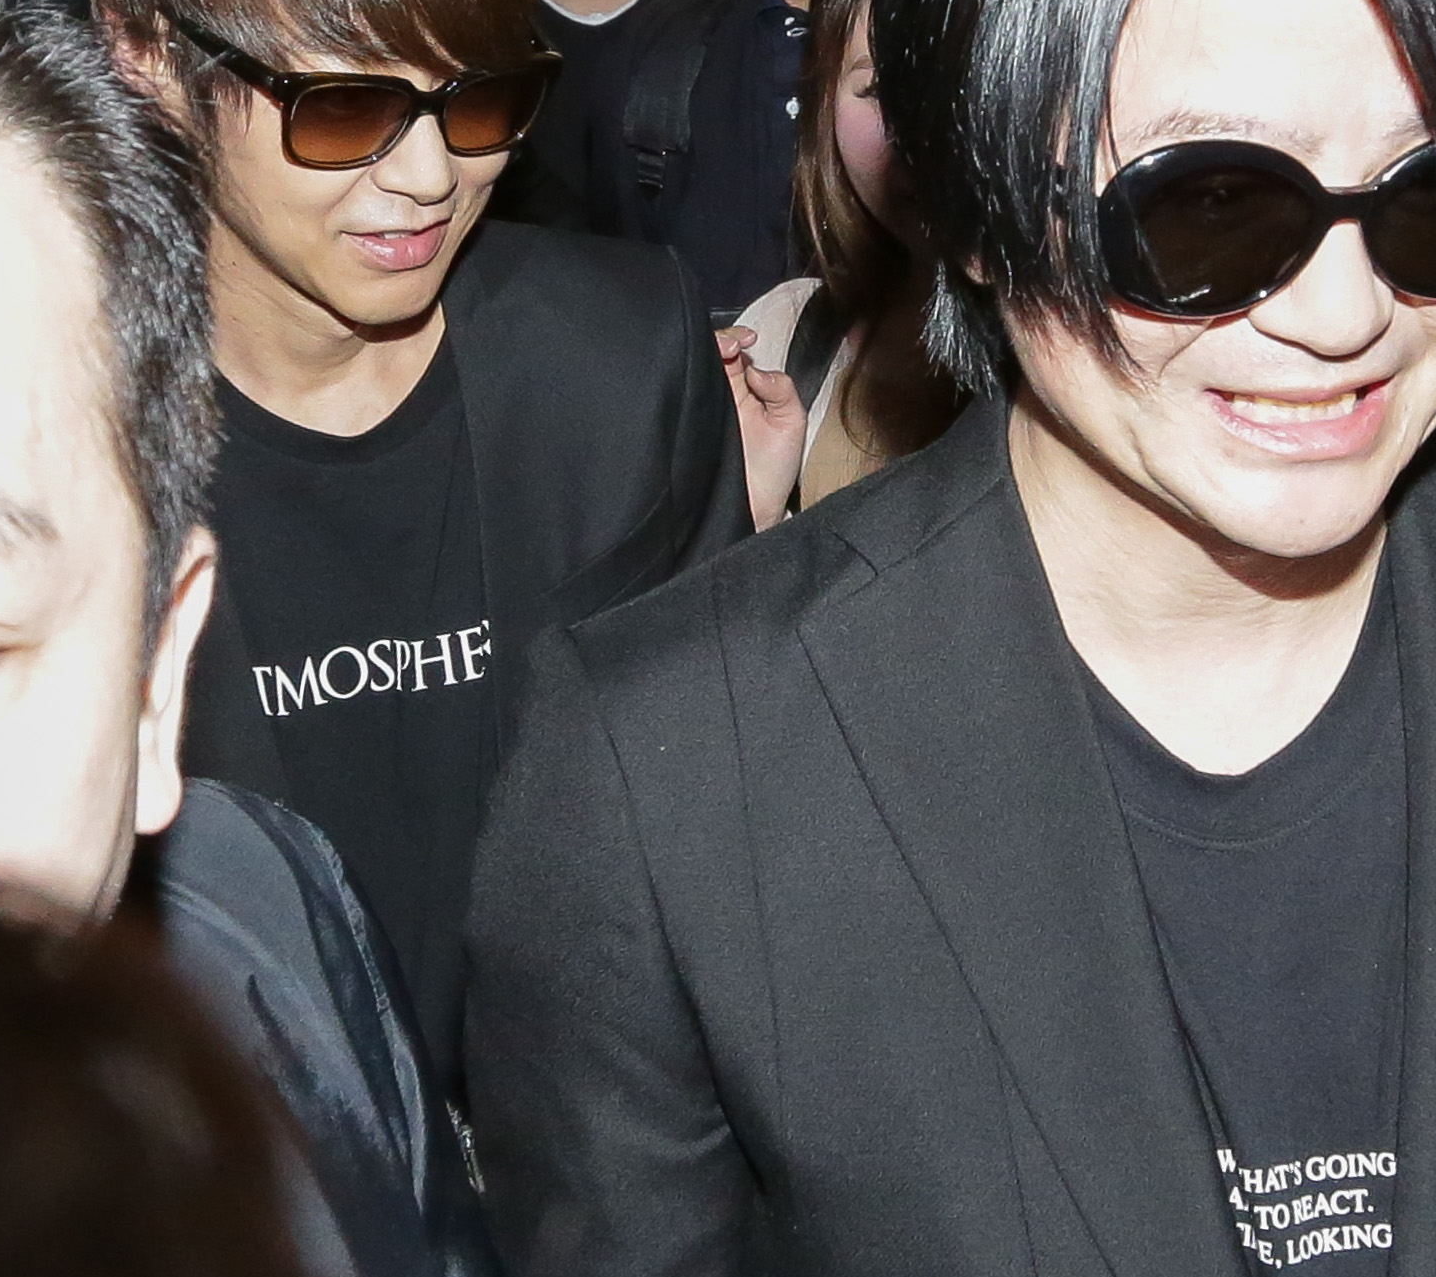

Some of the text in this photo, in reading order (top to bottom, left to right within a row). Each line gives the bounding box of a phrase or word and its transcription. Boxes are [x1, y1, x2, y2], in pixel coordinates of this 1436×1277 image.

[1305, 1151, 1397, 1182] GOING
[1253, 1203, 1290, 1230] TO
[1291, 1188, 1375, 1225] REACT.
[1286, 1223, 1393, 1265] LOOKING
